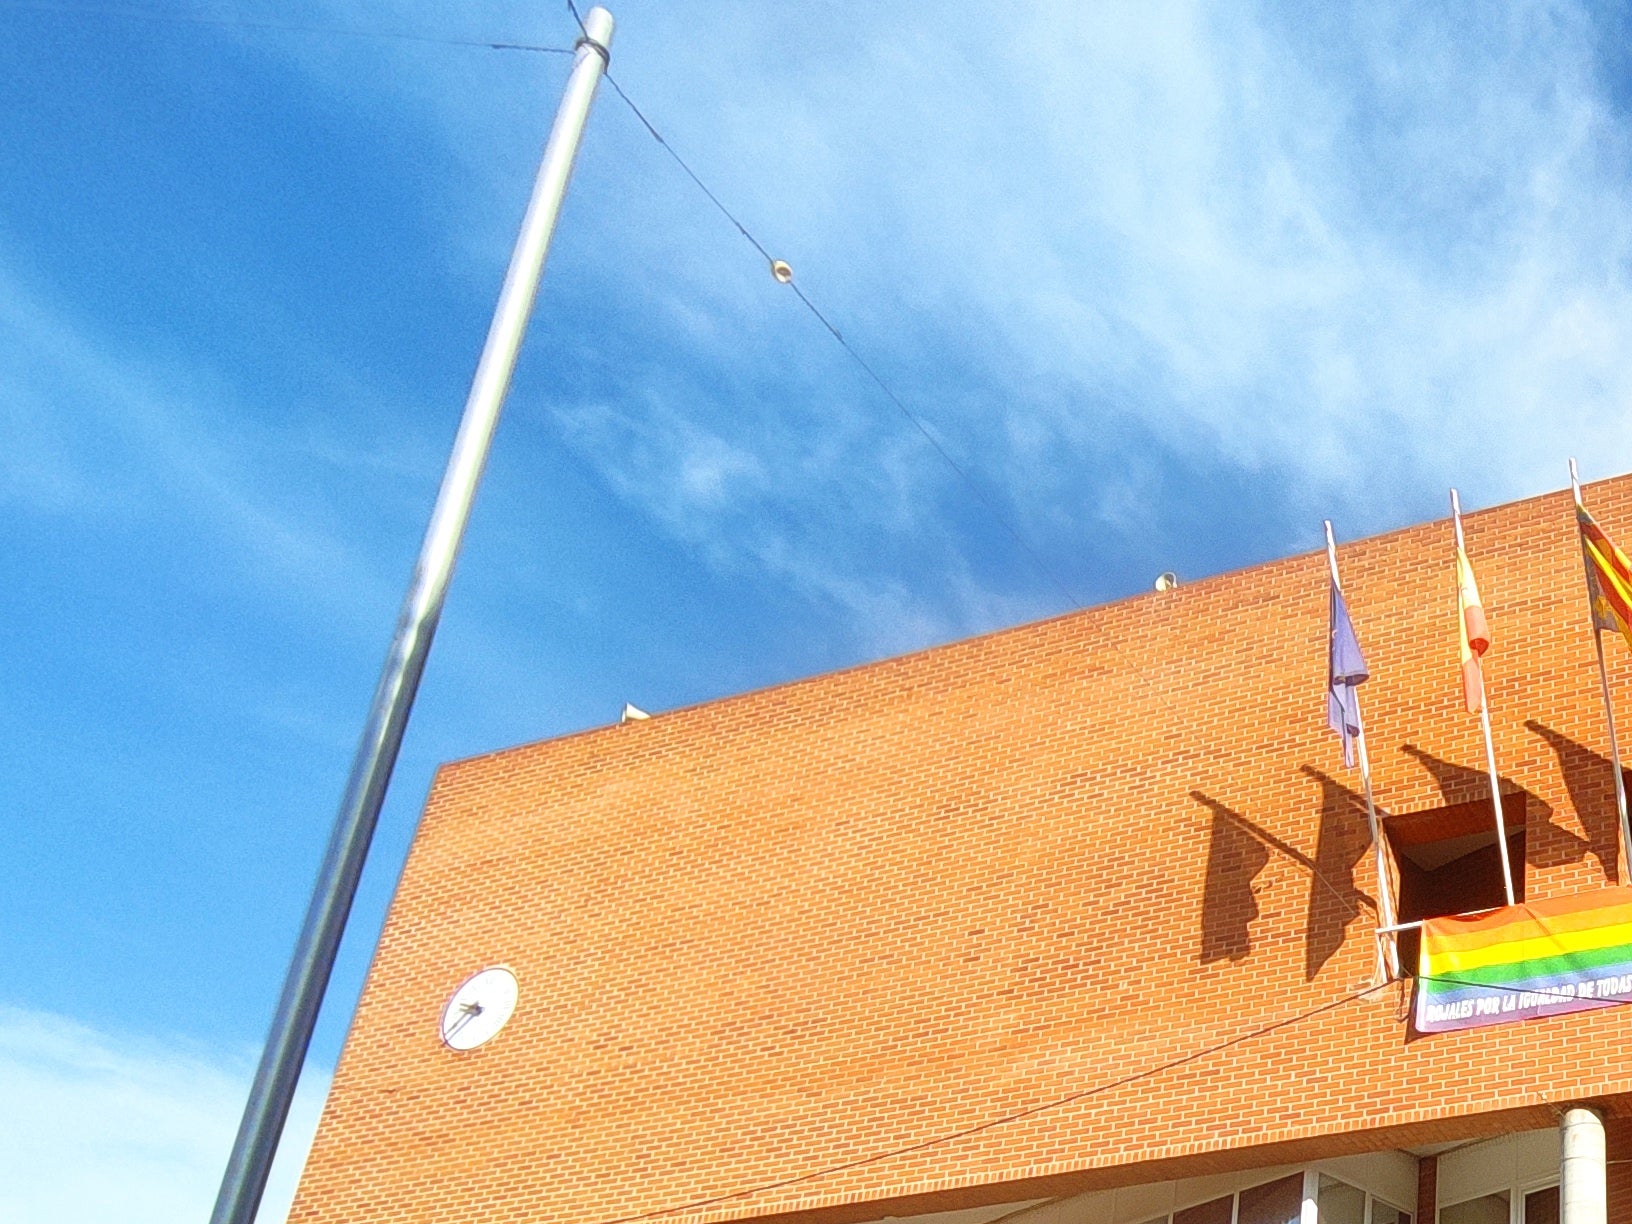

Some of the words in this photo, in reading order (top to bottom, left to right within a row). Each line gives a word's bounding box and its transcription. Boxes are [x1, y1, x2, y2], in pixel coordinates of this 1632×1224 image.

[1476, 996, 1499, 1016] POR
[1502, 994, 1516, 1012] LA
[1518, 984, 1575, 1010] IGUALDAD
[1578, 980, 1594, 999] DE
[1596, 974, 1632, 997] TODAS
